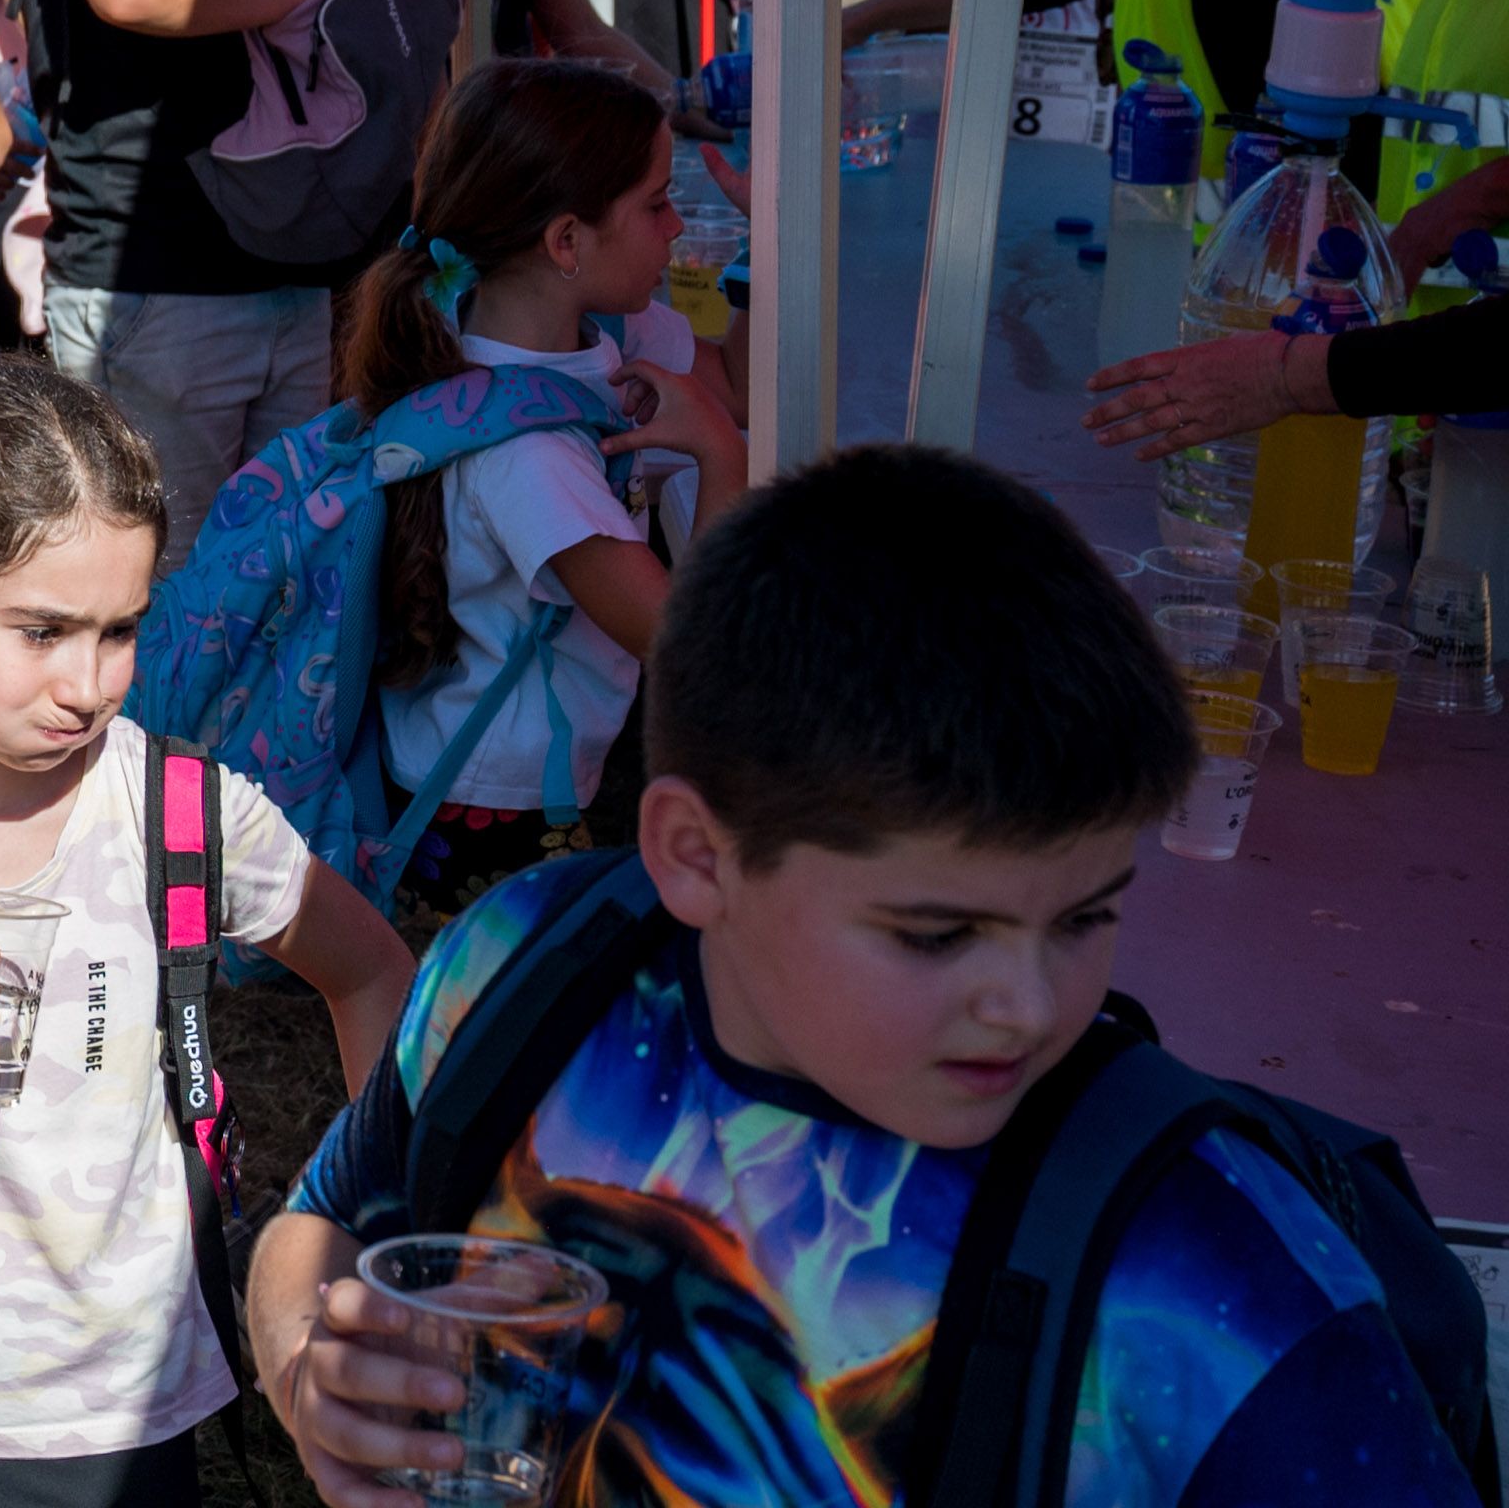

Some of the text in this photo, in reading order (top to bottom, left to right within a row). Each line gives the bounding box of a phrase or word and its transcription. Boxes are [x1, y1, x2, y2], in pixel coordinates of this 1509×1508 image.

[85, 960, 107, 1074] BE THE CHANGE
[182, 1004, 209, 1110] Quechua
